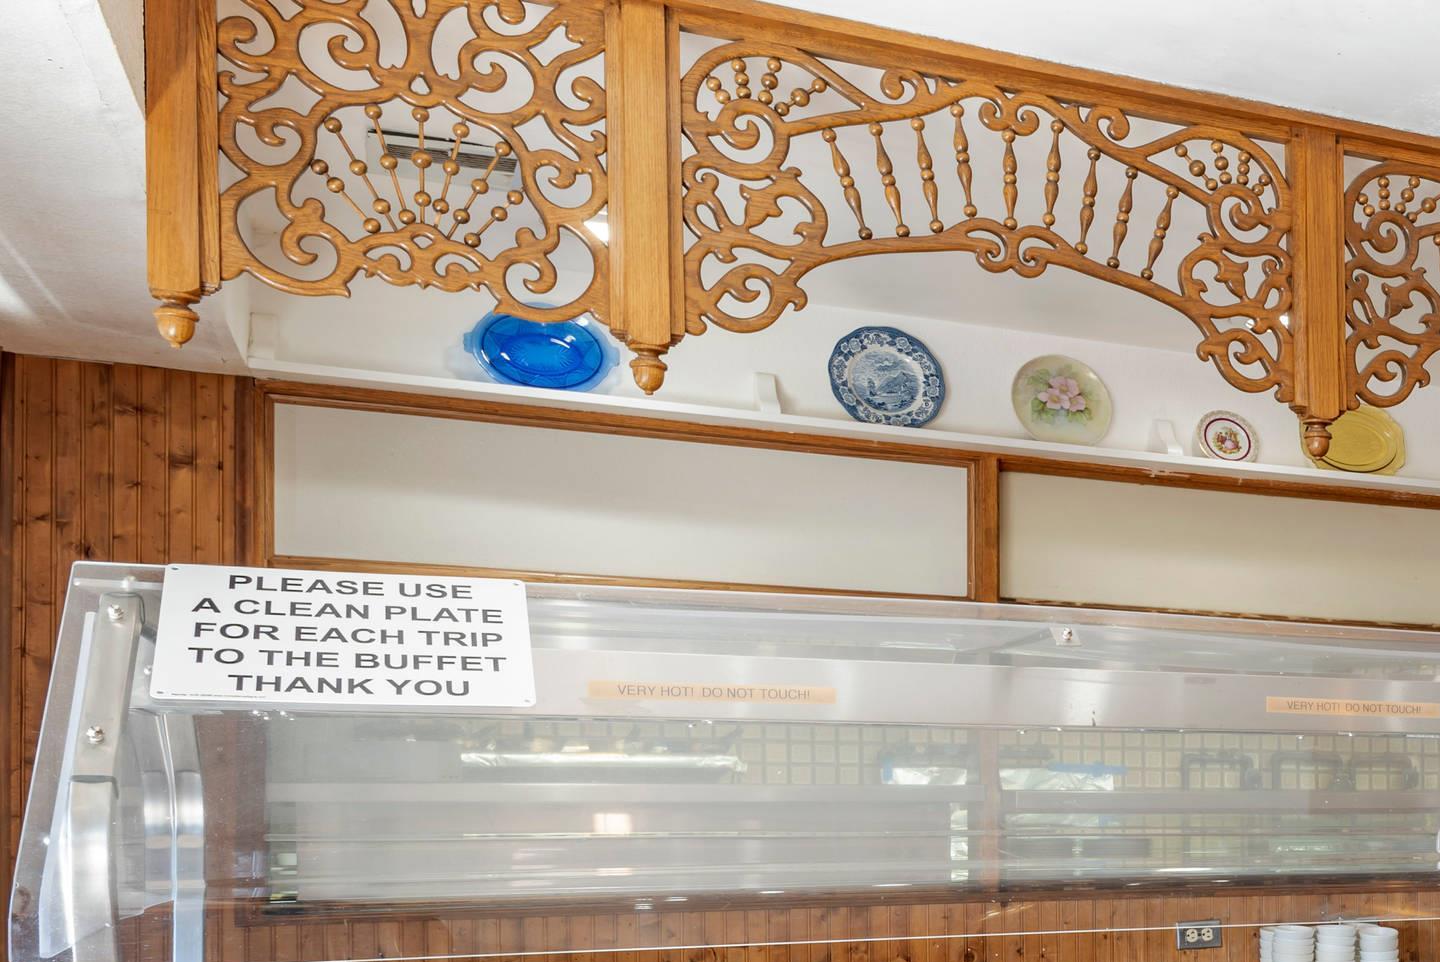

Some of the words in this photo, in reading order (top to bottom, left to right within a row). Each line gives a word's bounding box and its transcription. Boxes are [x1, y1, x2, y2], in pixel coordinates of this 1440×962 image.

[228, 574, 385, 597] PLEASE
[399, 582, 473, 600] USE
[191, 597, 221, 614] A
[234, 599, 369, 620] CLEAN
[384, 605, 504, 625] PLATE
[194, 622, 280, 642] FOR
[294, 626, 405, 646] EACH
[417, 630, 503, 648] TRIP
[187, 647, 245, 665] TO
[258, 649, 340, 669] THE
[355, 653, 507, 673] BUFFET
[227, 674, 375, 696] THANK
[386, 679, 470, 697] YOU
[617, 684, 656, 697] VERY
[660, 685, 694, 698] HOT!
[702, 686, 723, 699] DO
[727, 687, 755, 700] NOT
[760, 687, 811, 701] TOUCH!
[1287, 702, 1314, 710] VERY
[1345, 702, 1360, 712] DO
[1362, 703, 1382, 713] NOT
[1386, 703, 1421, 713] TOUCH!
